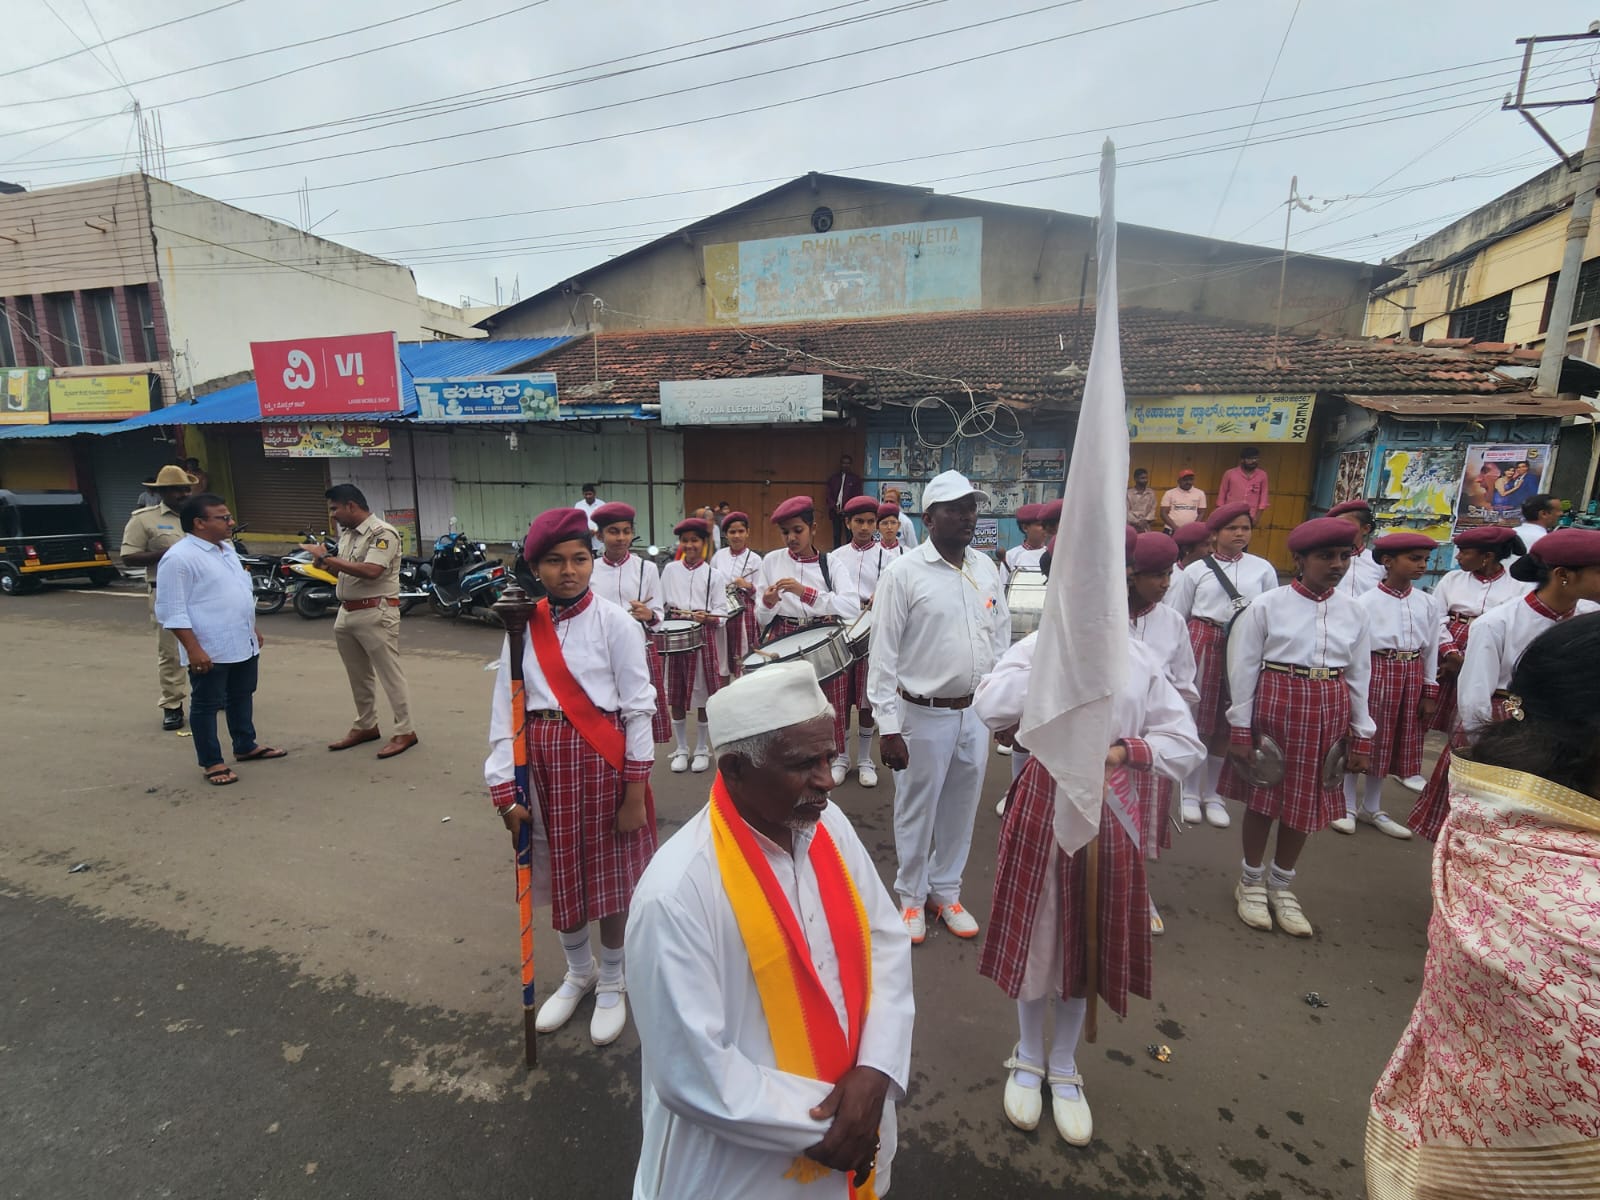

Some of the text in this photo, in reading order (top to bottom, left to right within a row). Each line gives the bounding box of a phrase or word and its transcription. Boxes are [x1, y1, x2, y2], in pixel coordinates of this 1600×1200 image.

[891, 226, 960, 246] PHILETTA
[283, 349, 316, 390] ವಿ
[727, 404, 781, 413] ELECTRICALS
[1292, 402, 1309, 438] ZEROX
